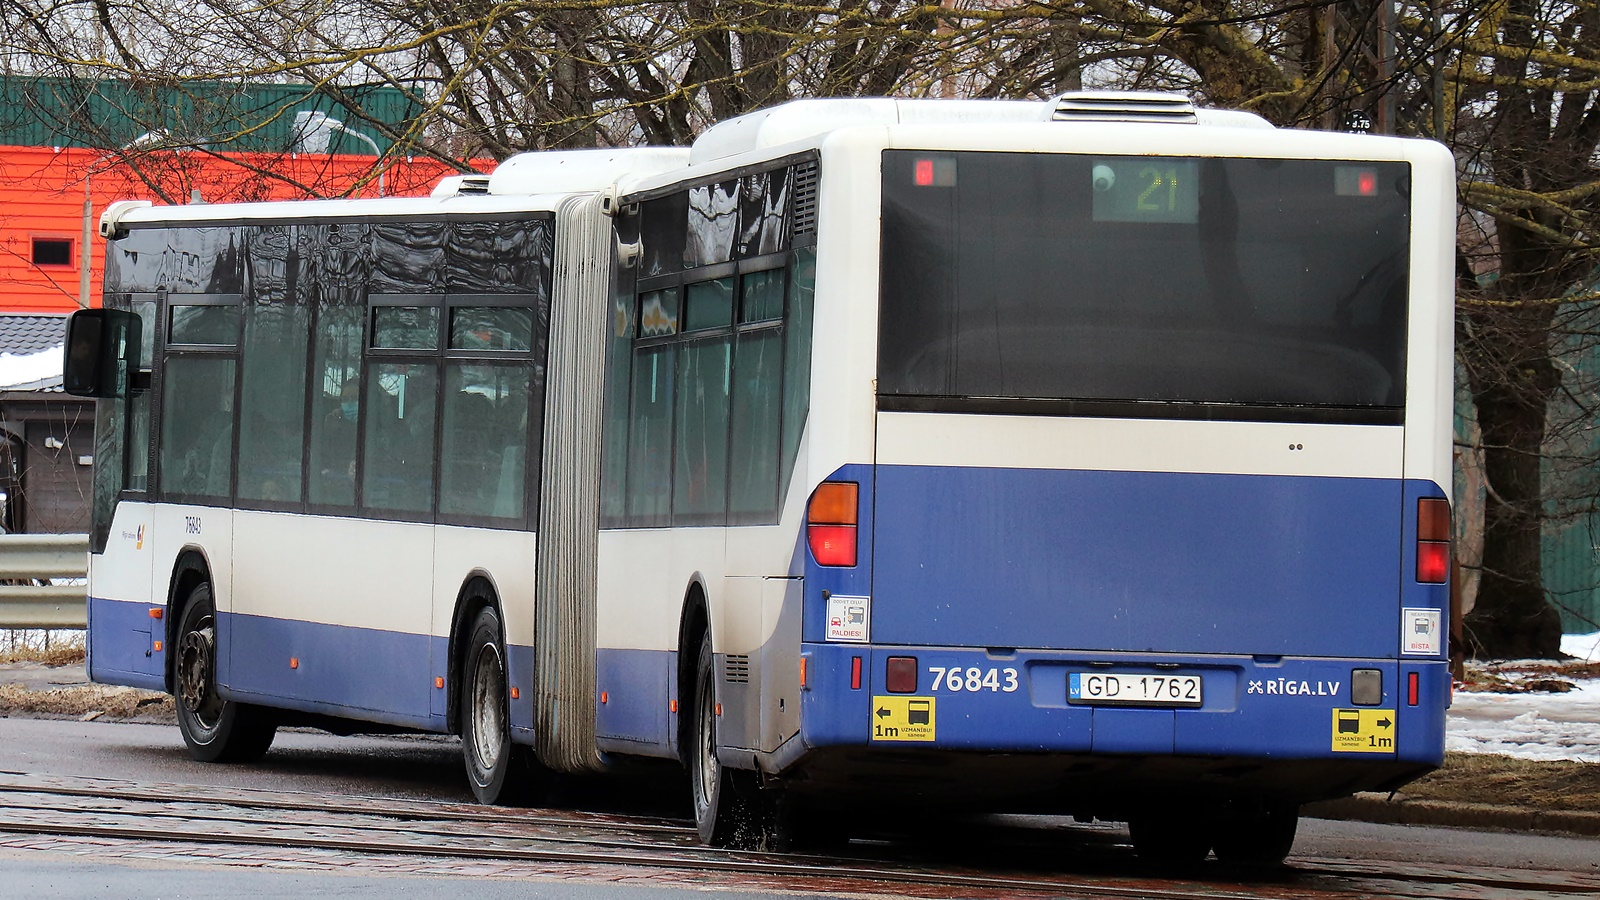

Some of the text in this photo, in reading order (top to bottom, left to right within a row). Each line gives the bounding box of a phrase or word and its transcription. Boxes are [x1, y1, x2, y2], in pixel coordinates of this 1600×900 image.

[1137, 166, 1177, 212] 21
[185, 516, 202, 534] 76843
[831, 629, 862, 637] PALDIES!
[928, 667, 1019, 693] 76843
[1266, 677, 1341, 696] RĪGA.LV
[875, 724, 899, 737] 1m
[1368, 735, 1392, 747] 1m
